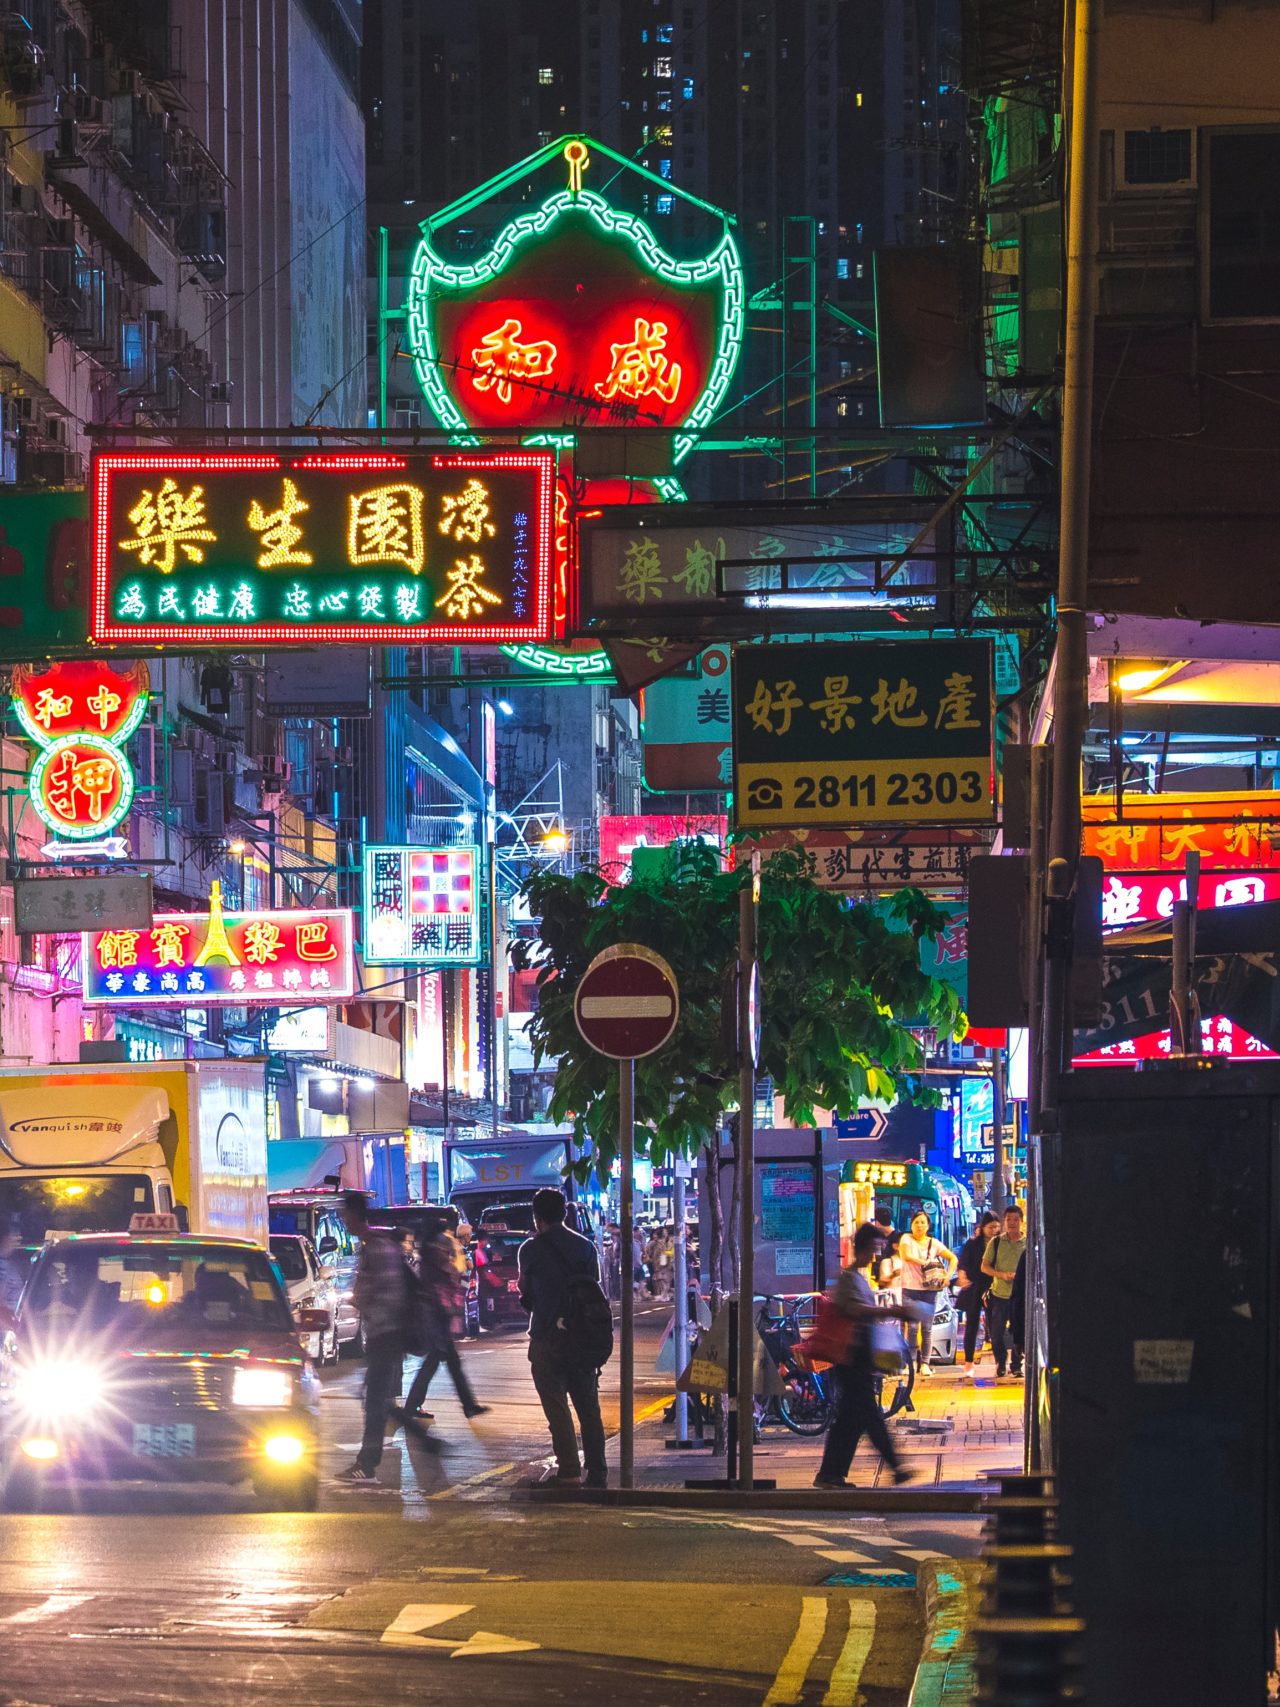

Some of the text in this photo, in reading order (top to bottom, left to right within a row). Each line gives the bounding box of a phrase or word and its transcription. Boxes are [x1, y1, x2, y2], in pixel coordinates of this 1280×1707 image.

[118, 477, 424, 575] 樂生園
[744, 671, 982, 737] 好景地產
[49, 750, 116, 821] 押
[793, 770, 983, 809] 2811 2303
[21, 1122, 88, 1133] Vanquish
[480, 1164, 524, 1182] LST
[135, 1215, 177, 1230] TAXI
